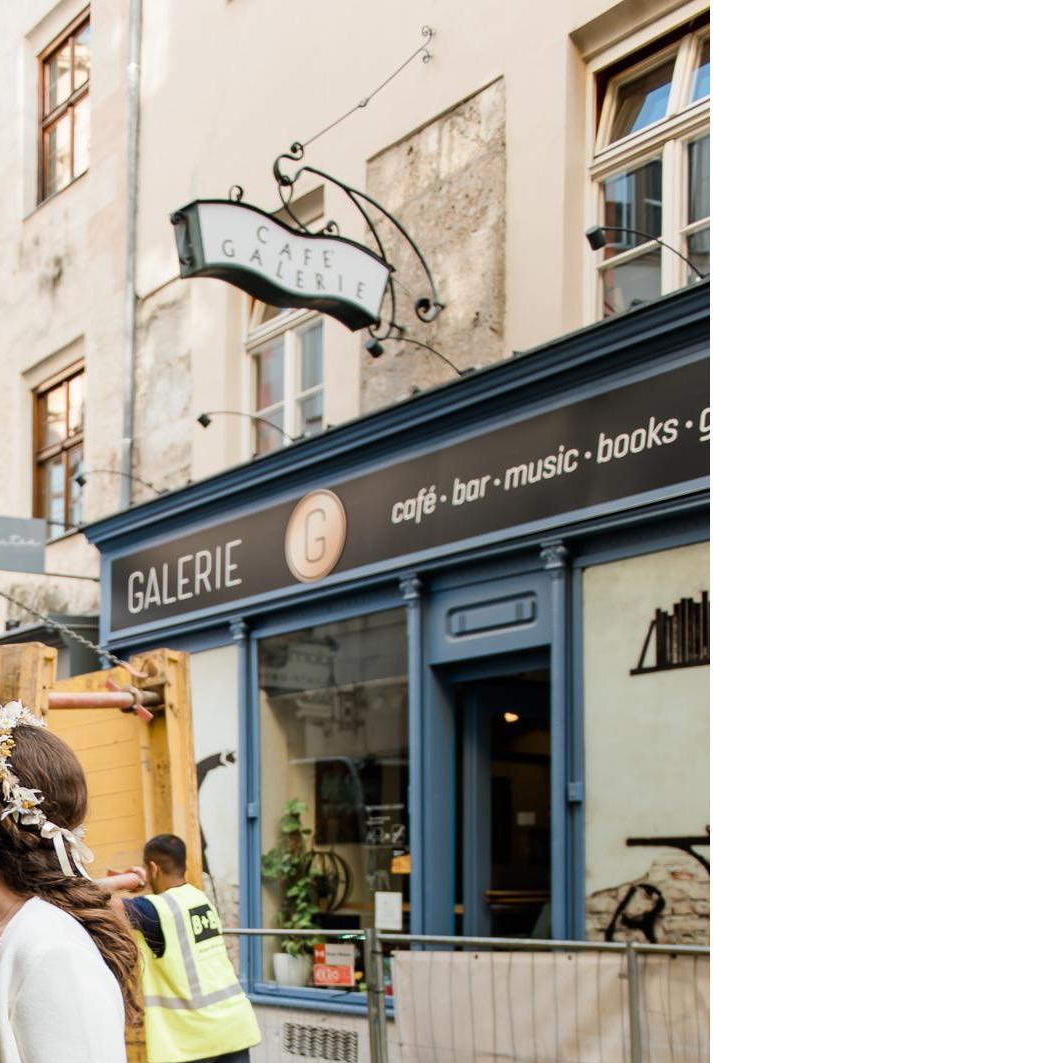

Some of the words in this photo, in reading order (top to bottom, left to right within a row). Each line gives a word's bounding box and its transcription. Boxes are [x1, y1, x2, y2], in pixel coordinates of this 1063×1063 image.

[221, 239, 366, 299] GALERIE
[391, 484, 438, 524] café
[452, 475, 491, 506] bar
[504, 444, 579, 491] music
[596, 416, 679, 464] books
[305, 508, 327, 564] G
[128, 539, 243, 614] GALERIE
